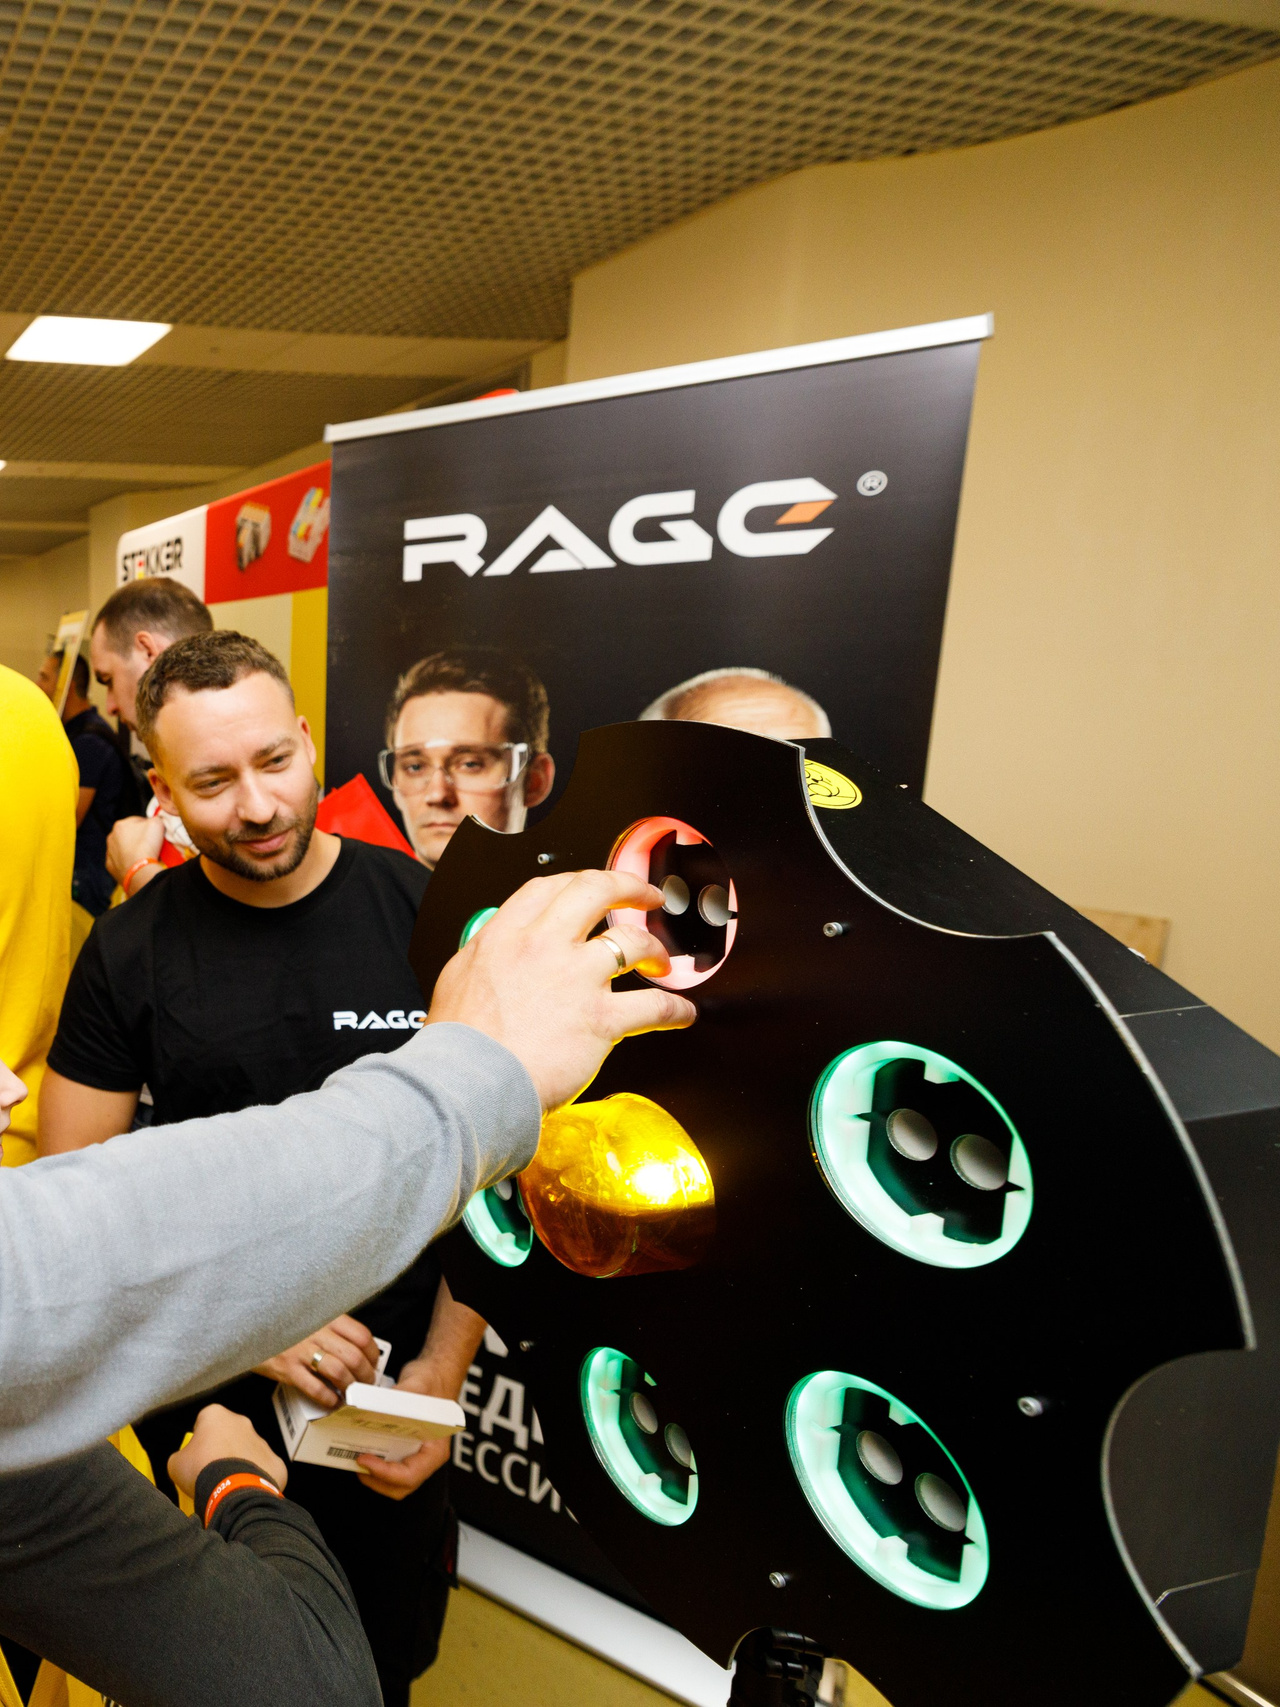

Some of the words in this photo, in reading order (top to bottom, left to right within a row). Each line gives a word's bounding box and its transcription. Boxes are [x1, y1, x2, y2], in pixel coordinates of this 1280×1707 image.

[403, 477, 838, 582] RAGE
[122, 535, 183, 582] STEKKER
[213, 1479, 231, 1499] 2024
